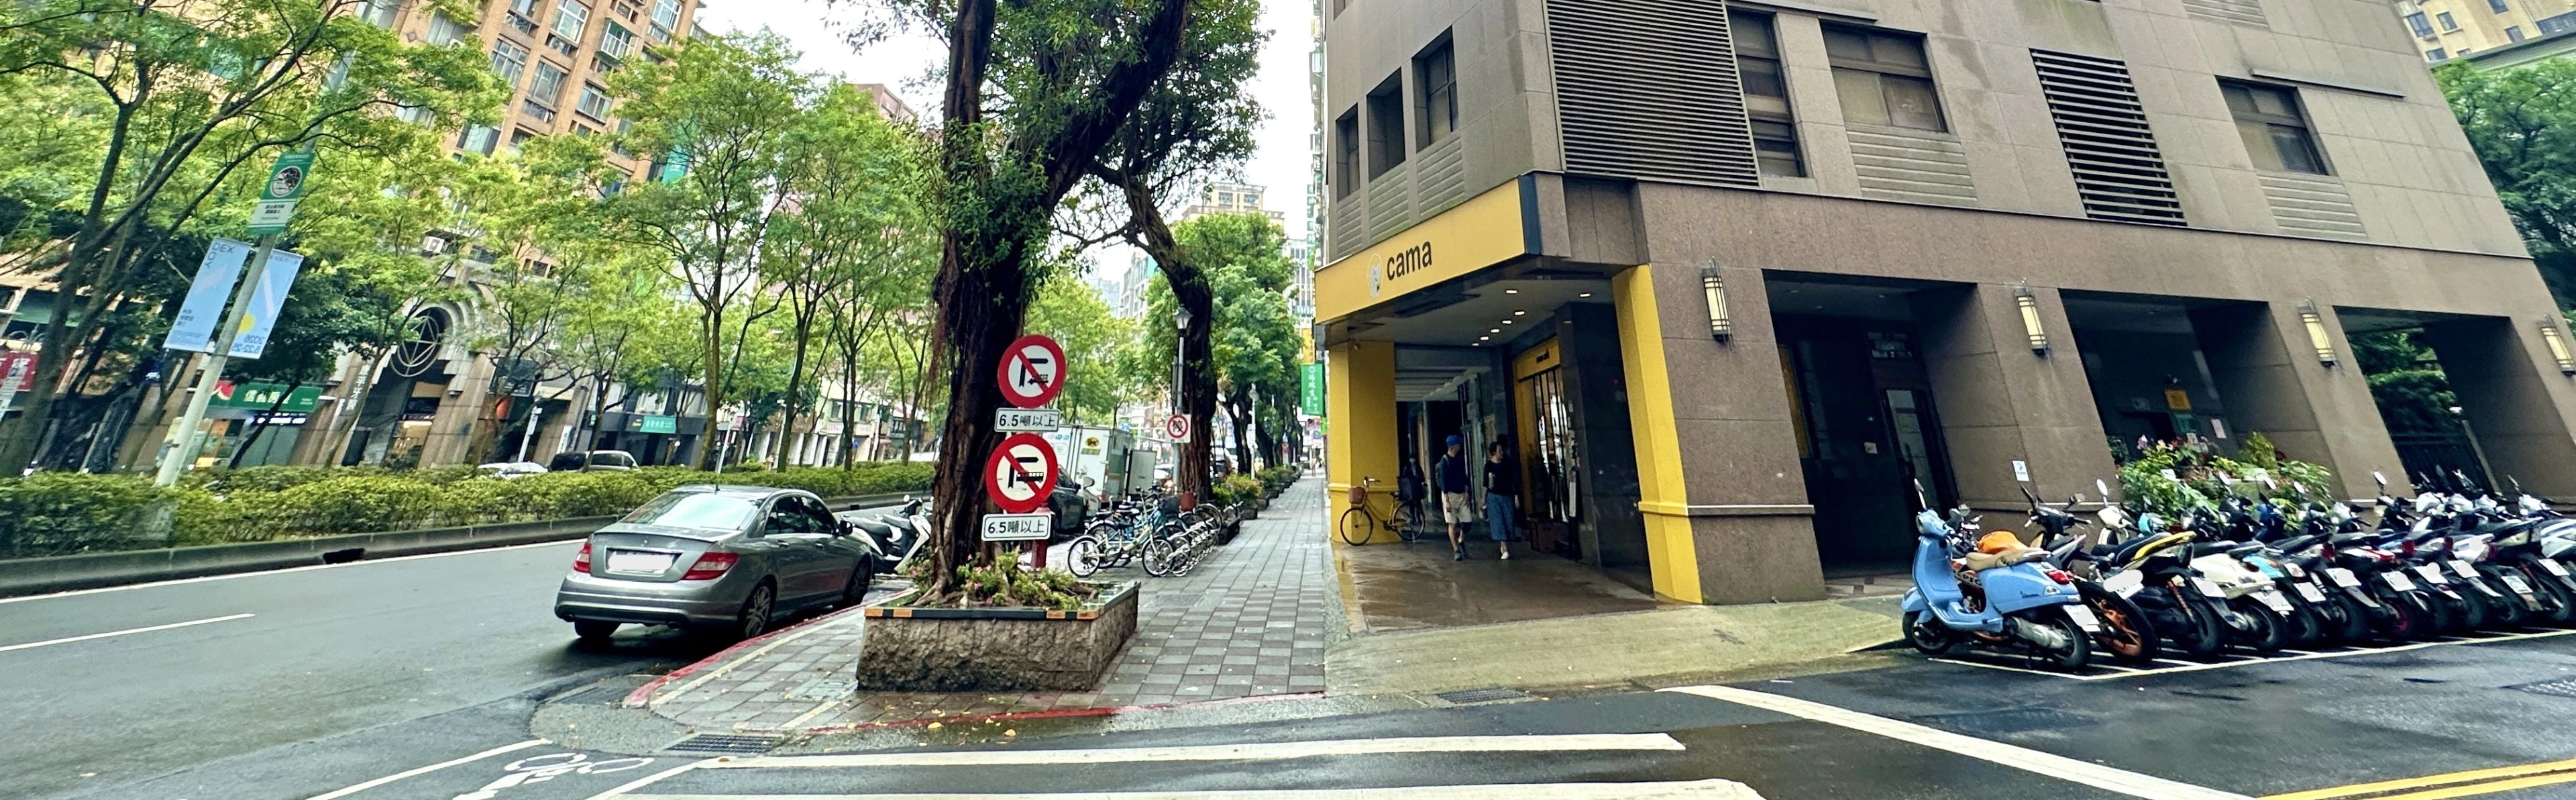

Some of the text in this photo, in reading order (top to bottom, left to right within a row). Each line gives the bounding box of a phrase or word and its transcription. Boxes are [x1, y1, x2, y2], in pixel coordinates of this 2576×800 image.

[1387, 241, 1432, 281] cama
[999, 414, 1056, 428] 6.5噸以上
[987, 519, 1045, 534] 6.5噸以上
